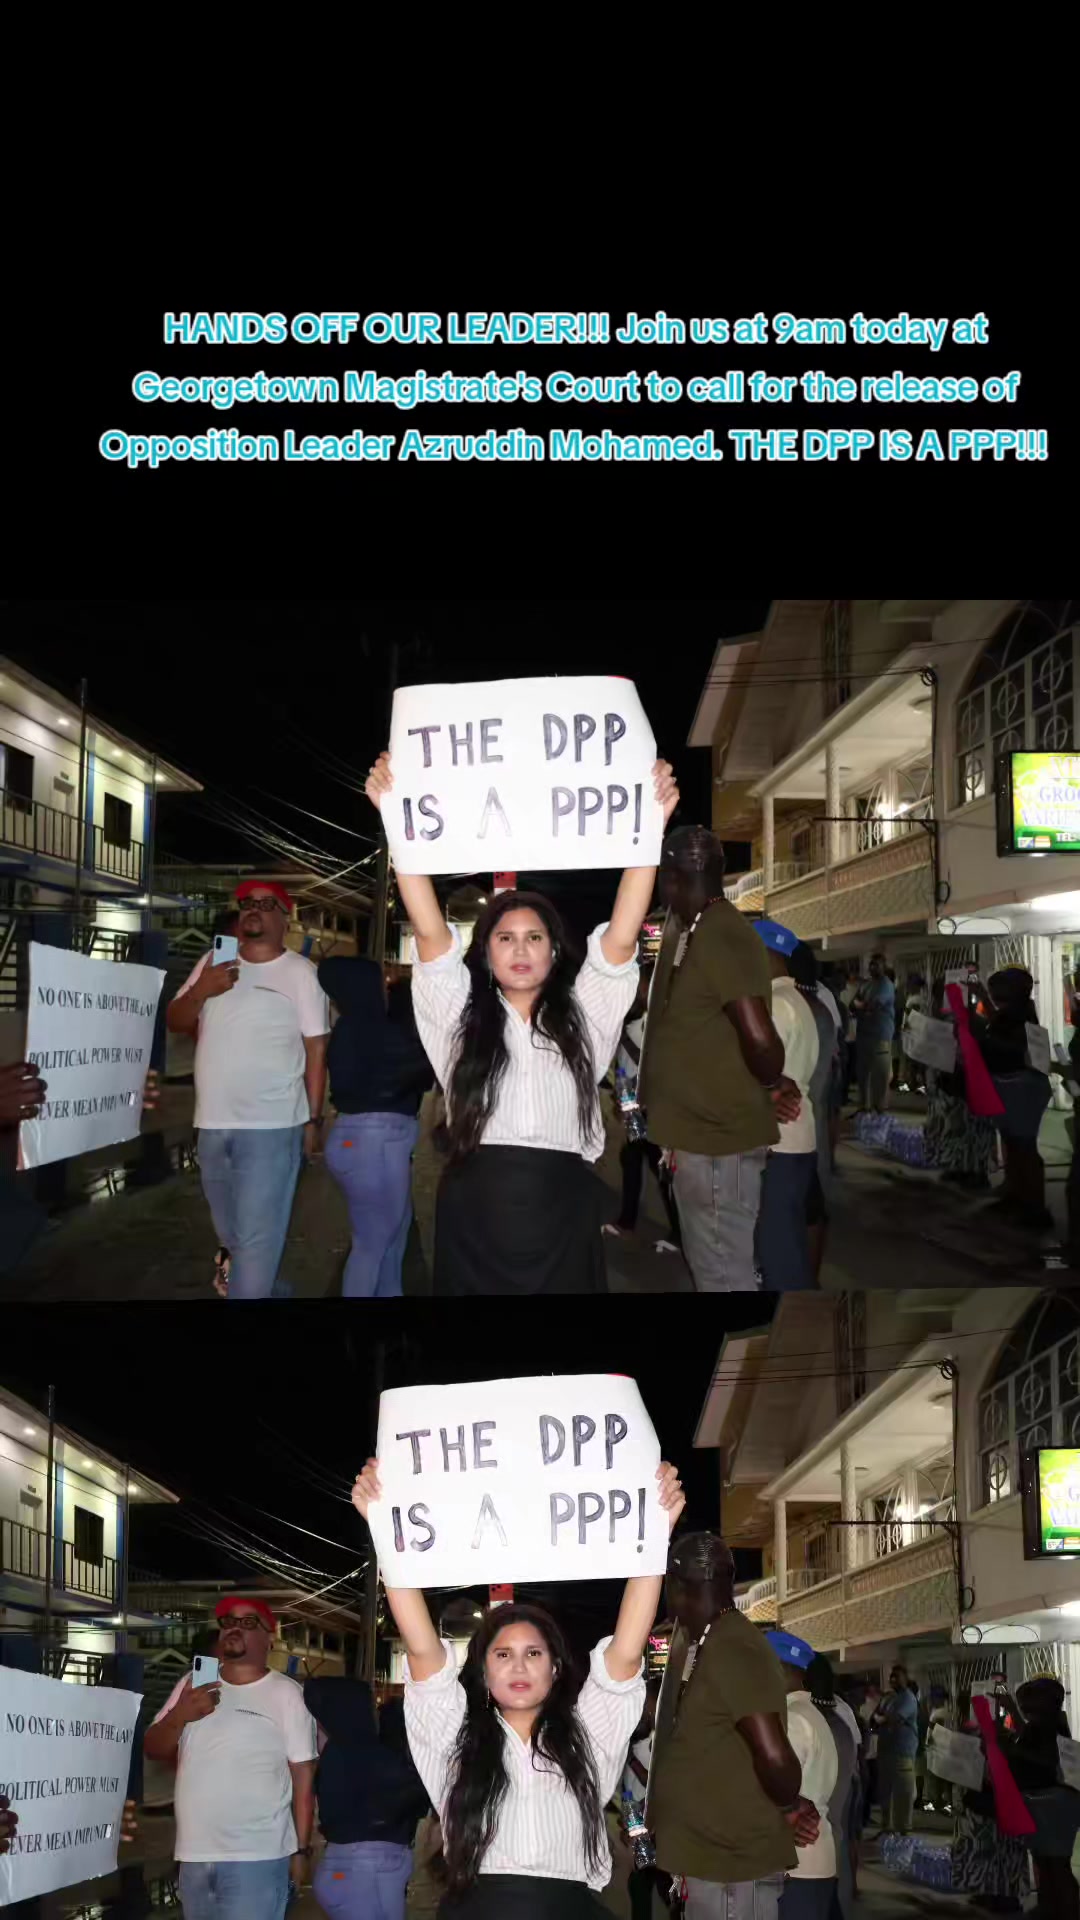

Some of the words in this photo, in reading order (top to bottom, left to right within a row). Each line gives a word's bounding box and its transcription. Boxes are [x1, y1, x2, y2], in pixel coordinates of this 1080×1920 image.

[407, 717, 504, 768] THE
[542, 712, 627, 767] DPP
[402, 793, 445, 841] IS
[476, 786, 513, 840] A
[551, 783, 643, 845] PPP!
[37, 986, 56, 1006] NO
[59, 989, 81, 1010] ONE
[83, 993, 93, 1010] IS
[29, 1049, 89, 1070] POLITICAL
[91, 1047, 122, 1065] POWER
[125, 1048, 144, 1064] MUST
[73, 1097, 98, 1117] MEAN
[395, 1420, 498, 1474] THE
[538, 1413, 628, 1470] DPP
[391, 1502, 436, 1553] IS
[471, 1493, 509, 1549] A
[550, 1487, 646, 1553] PPP!
[6, 1713, 25, 1734] NO
[28, 1715, 54, 1737] ONE
[55, 1718, 65, 1737] IS
[68, 1720, 99, 1740] ABOVE
[0, 1778, 62, 1801] POLITICAL
[64, 1776, 96, 1794] POWER
[99, 1776, 119, 1793] MUST
[9, 1833, 42, 1856] EVER
[46, 1830, 73, 1851] MEAN
